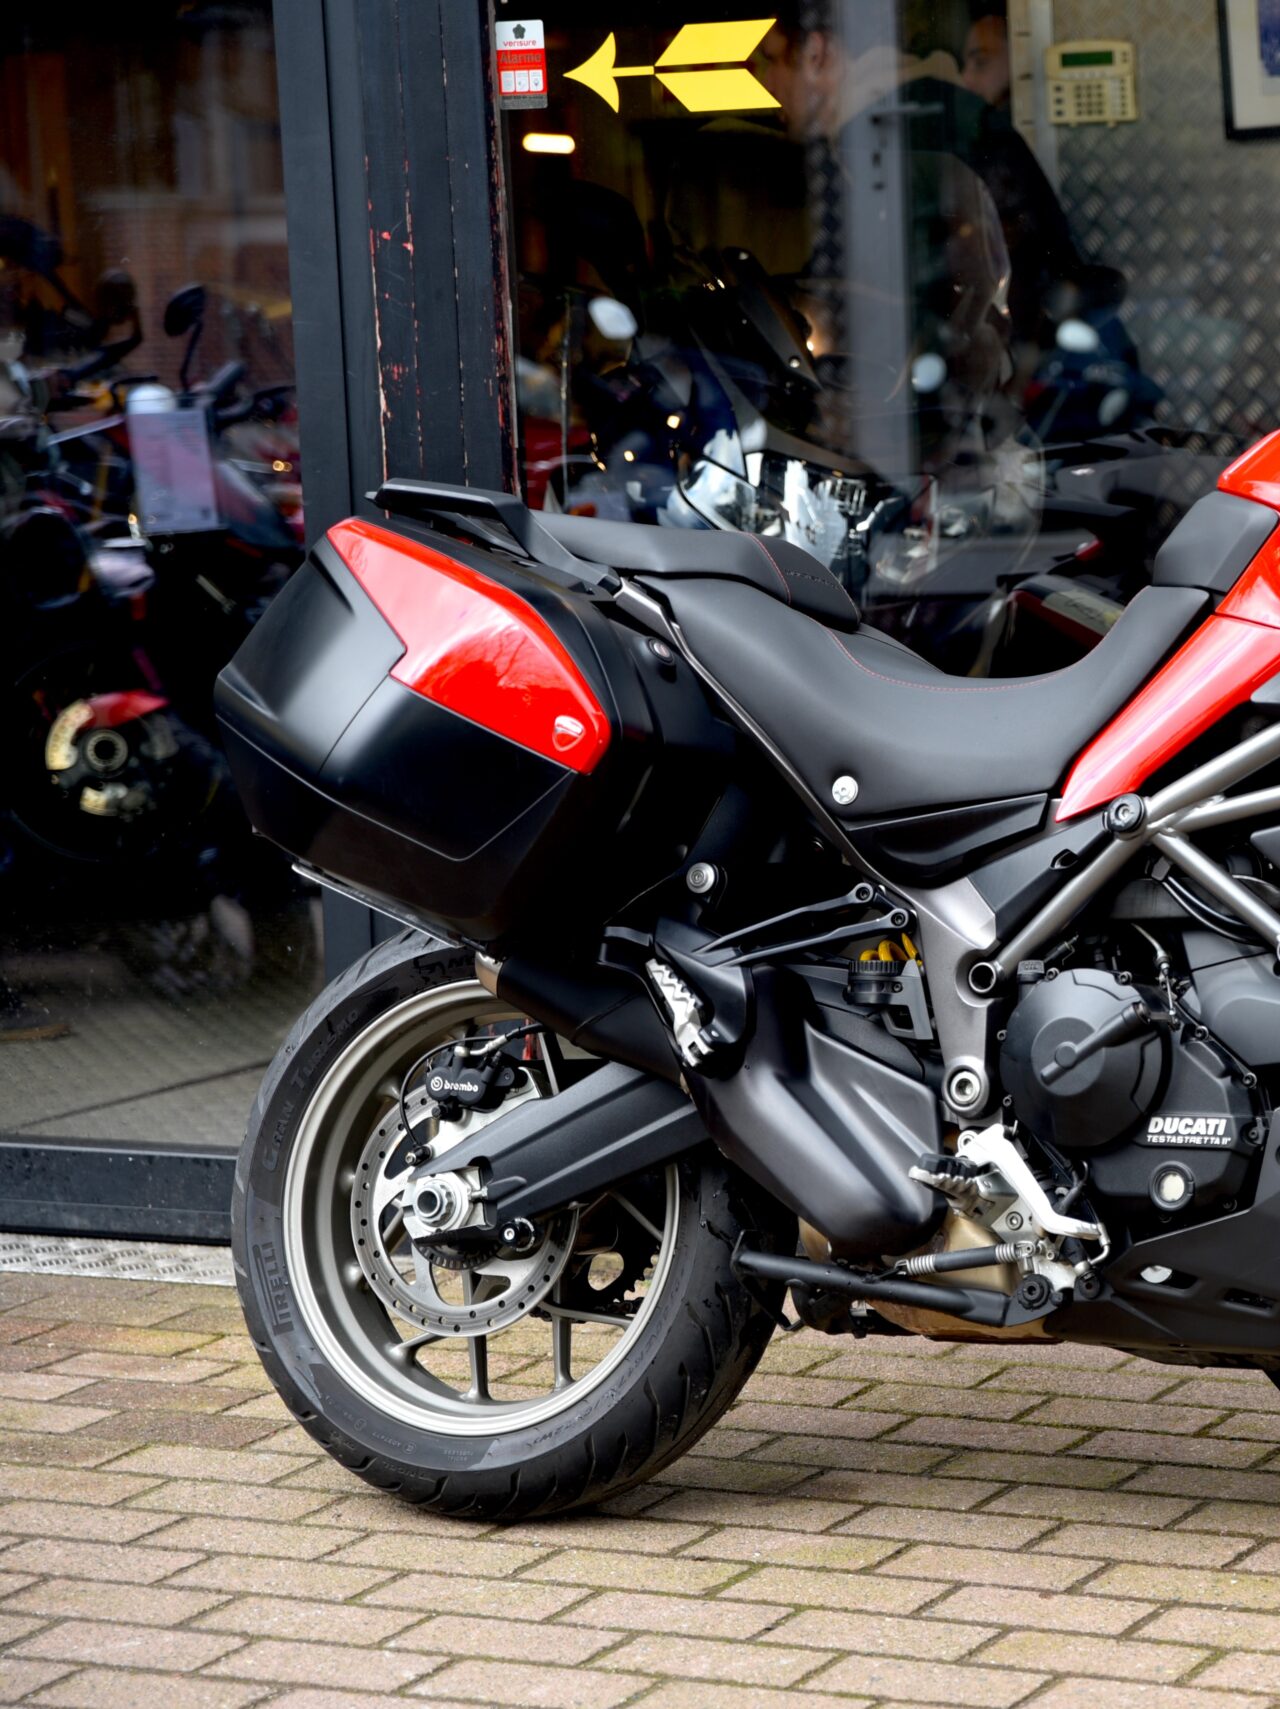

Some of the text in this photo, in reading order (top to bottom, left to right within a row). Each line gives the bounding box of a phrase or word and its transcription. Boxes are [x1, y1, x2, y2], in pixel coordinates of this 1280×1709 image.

[443, 1080, 479, 1093] brembo
[1147, 1116, 1227, 1136] DUCATI
[1146, 1134, 1220, 1145] TESTASTRETTA
[252, 1241, 295, 1337] PIRELLI
